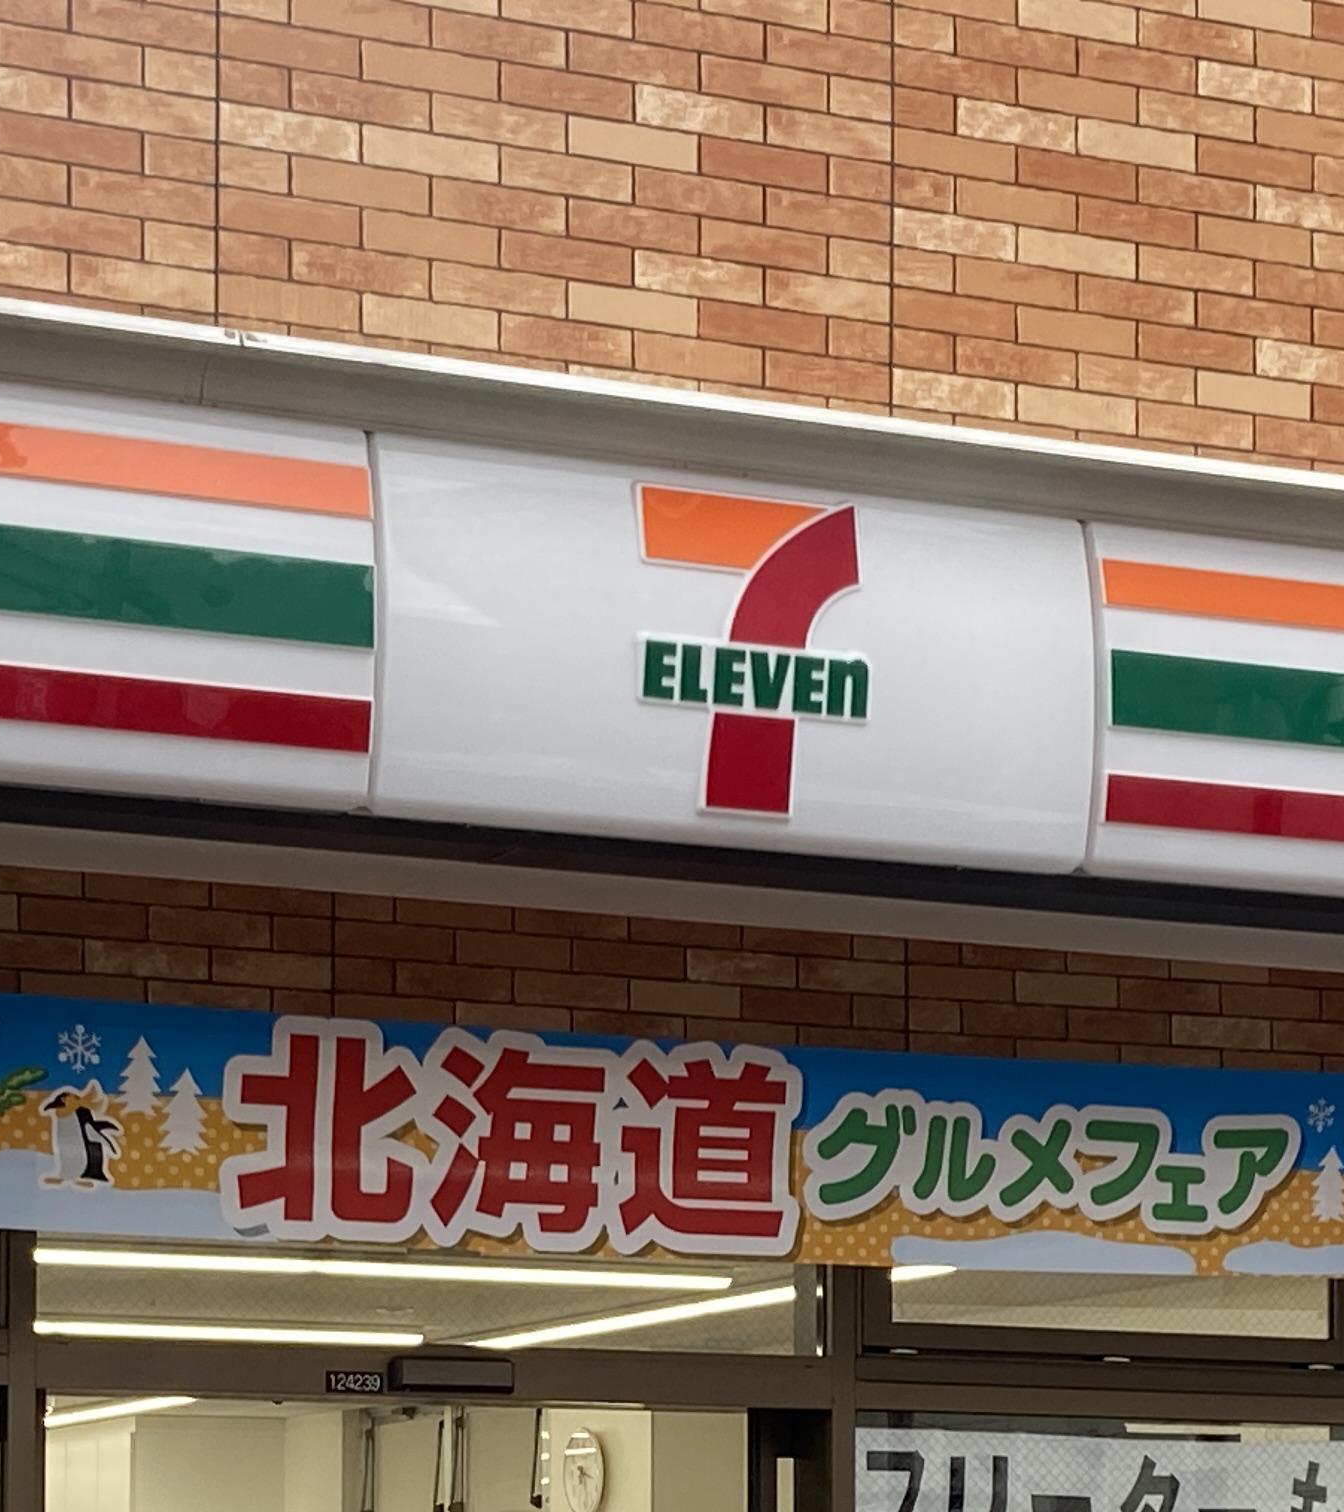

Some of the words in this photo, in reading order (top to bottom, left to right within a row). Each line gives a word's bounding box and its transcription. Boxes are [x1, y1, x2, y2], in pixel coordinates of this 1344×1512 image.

[234, 1030, 794, 1240] 北海道
[814, 1104, 1294, 1226] グルメフェア
[329, 1373, 381, 1392] 124239
